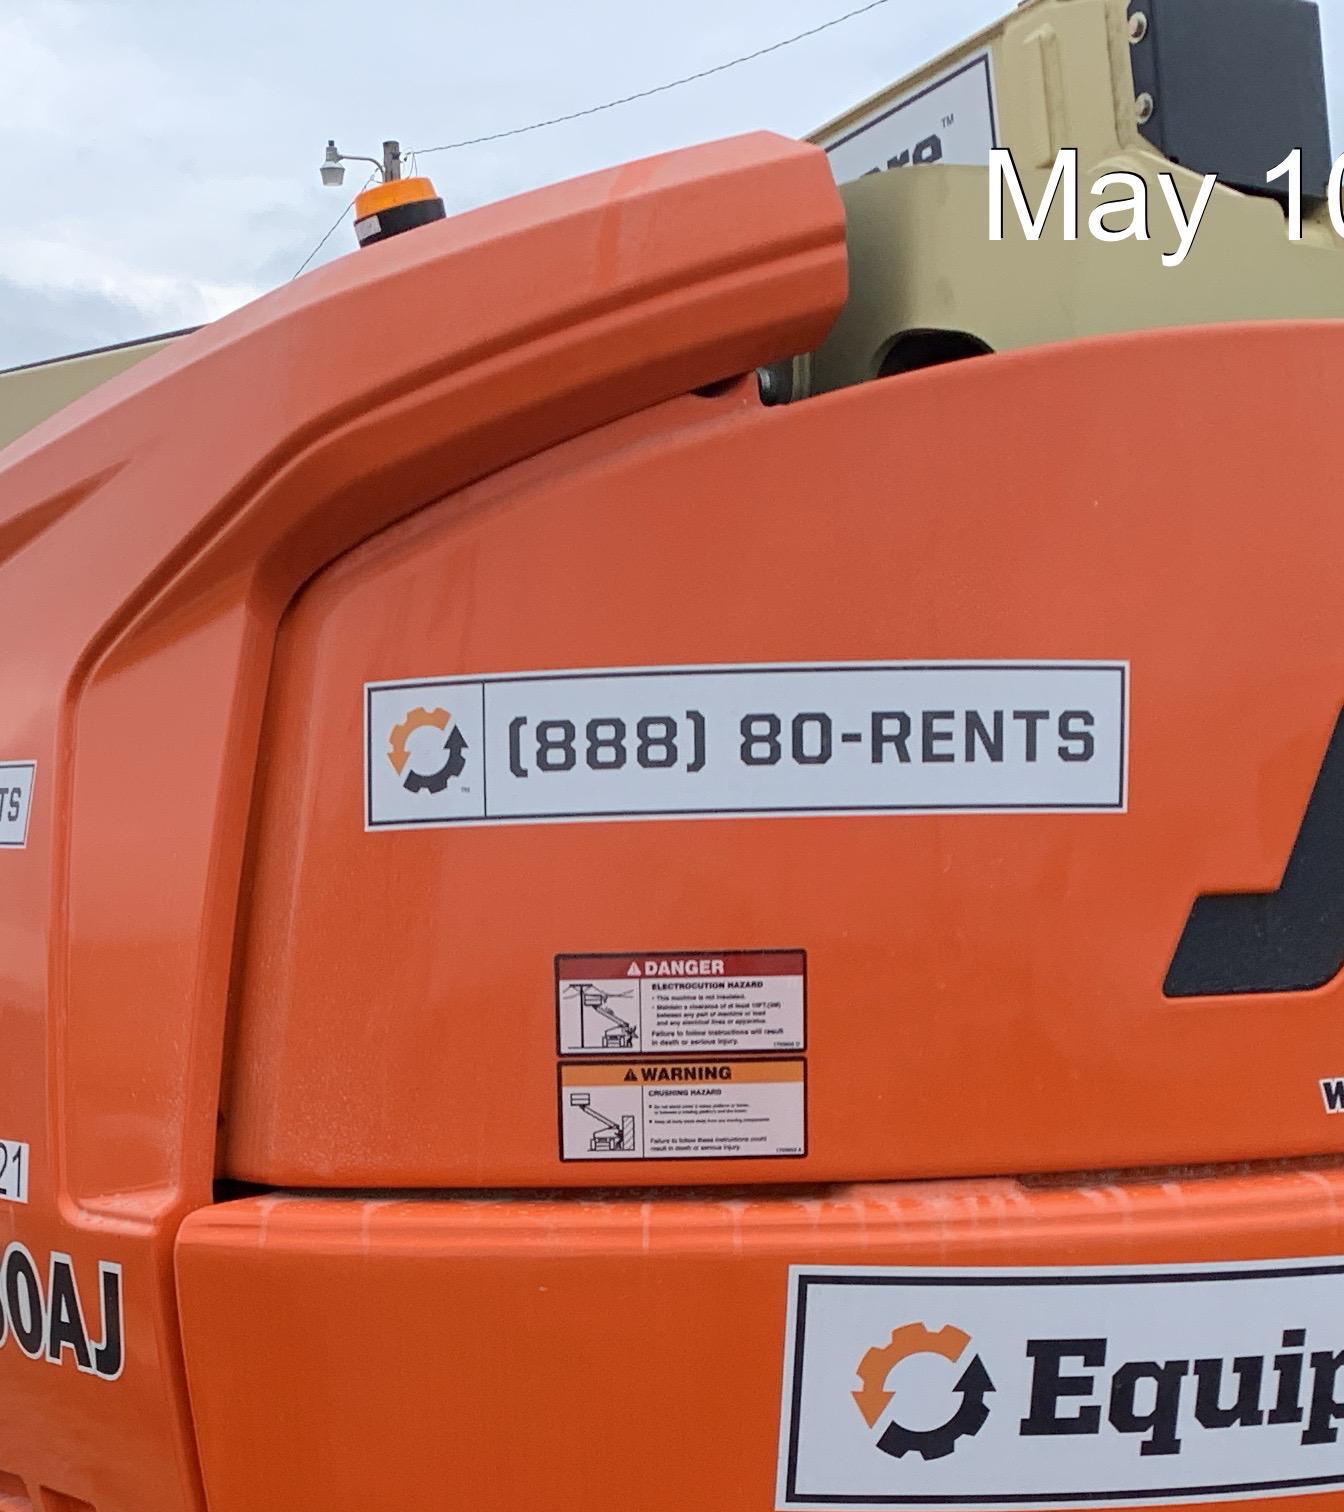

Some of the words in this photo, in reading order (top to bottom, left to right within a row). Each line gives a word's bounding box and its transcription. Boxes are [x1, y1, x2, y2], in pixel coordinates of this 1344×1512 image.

[508, 711, 707, 779] (888)
[739, 708, 1098, 768] 80-RENTS
[644, 960, 725, 976] DANGER
[651, 981, 725, 991] ELECTROCUTION
[727, 981, 764, 989] HAZARD
[641, 1066, 732, 1081] WARNING
[648, 1089, 689, 1097] CRUSHING
[690, 1088, 722, 1096] HAZARD
